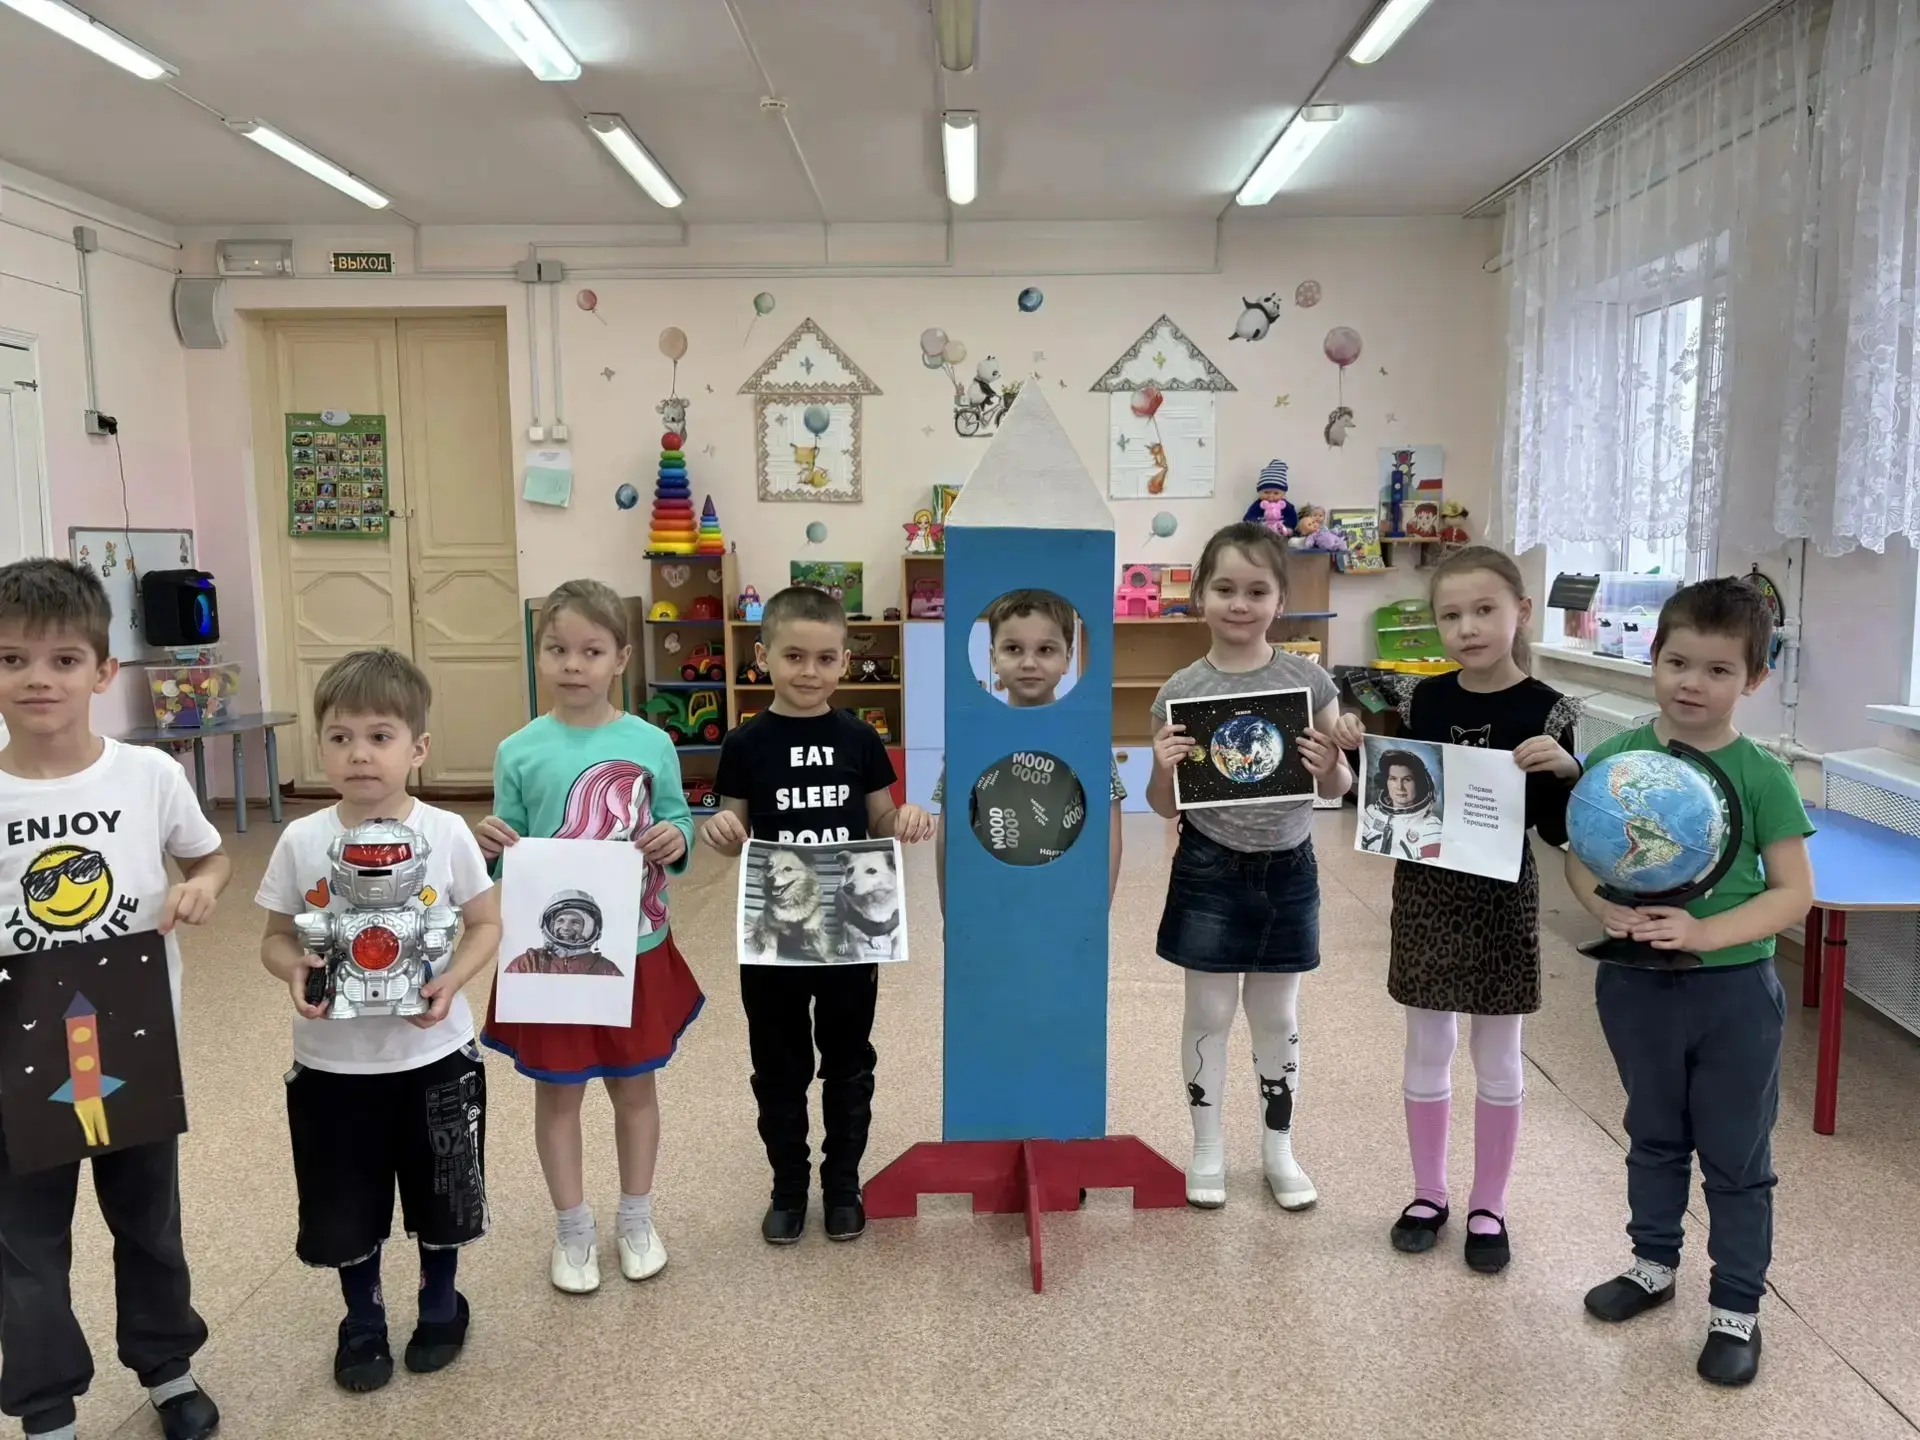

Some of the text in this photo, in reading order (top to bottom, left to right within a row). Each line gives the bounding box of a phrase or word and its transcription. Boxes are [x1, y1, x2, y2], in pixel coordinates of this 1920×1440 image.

[338, 256, 387, 270] ВЫХОД
[790, 745, 834, 767] EAT
[1012, 751, 1055, 773] MOOD
[1011, 763, 1051, 785] GOOD
[775, 784, 850, 811] SLEEP
[7, 810, 121, 846] ENJOY
[989, 807, 1007, 850] MOOD
[1003, 808, 1020, 848] GOOD
